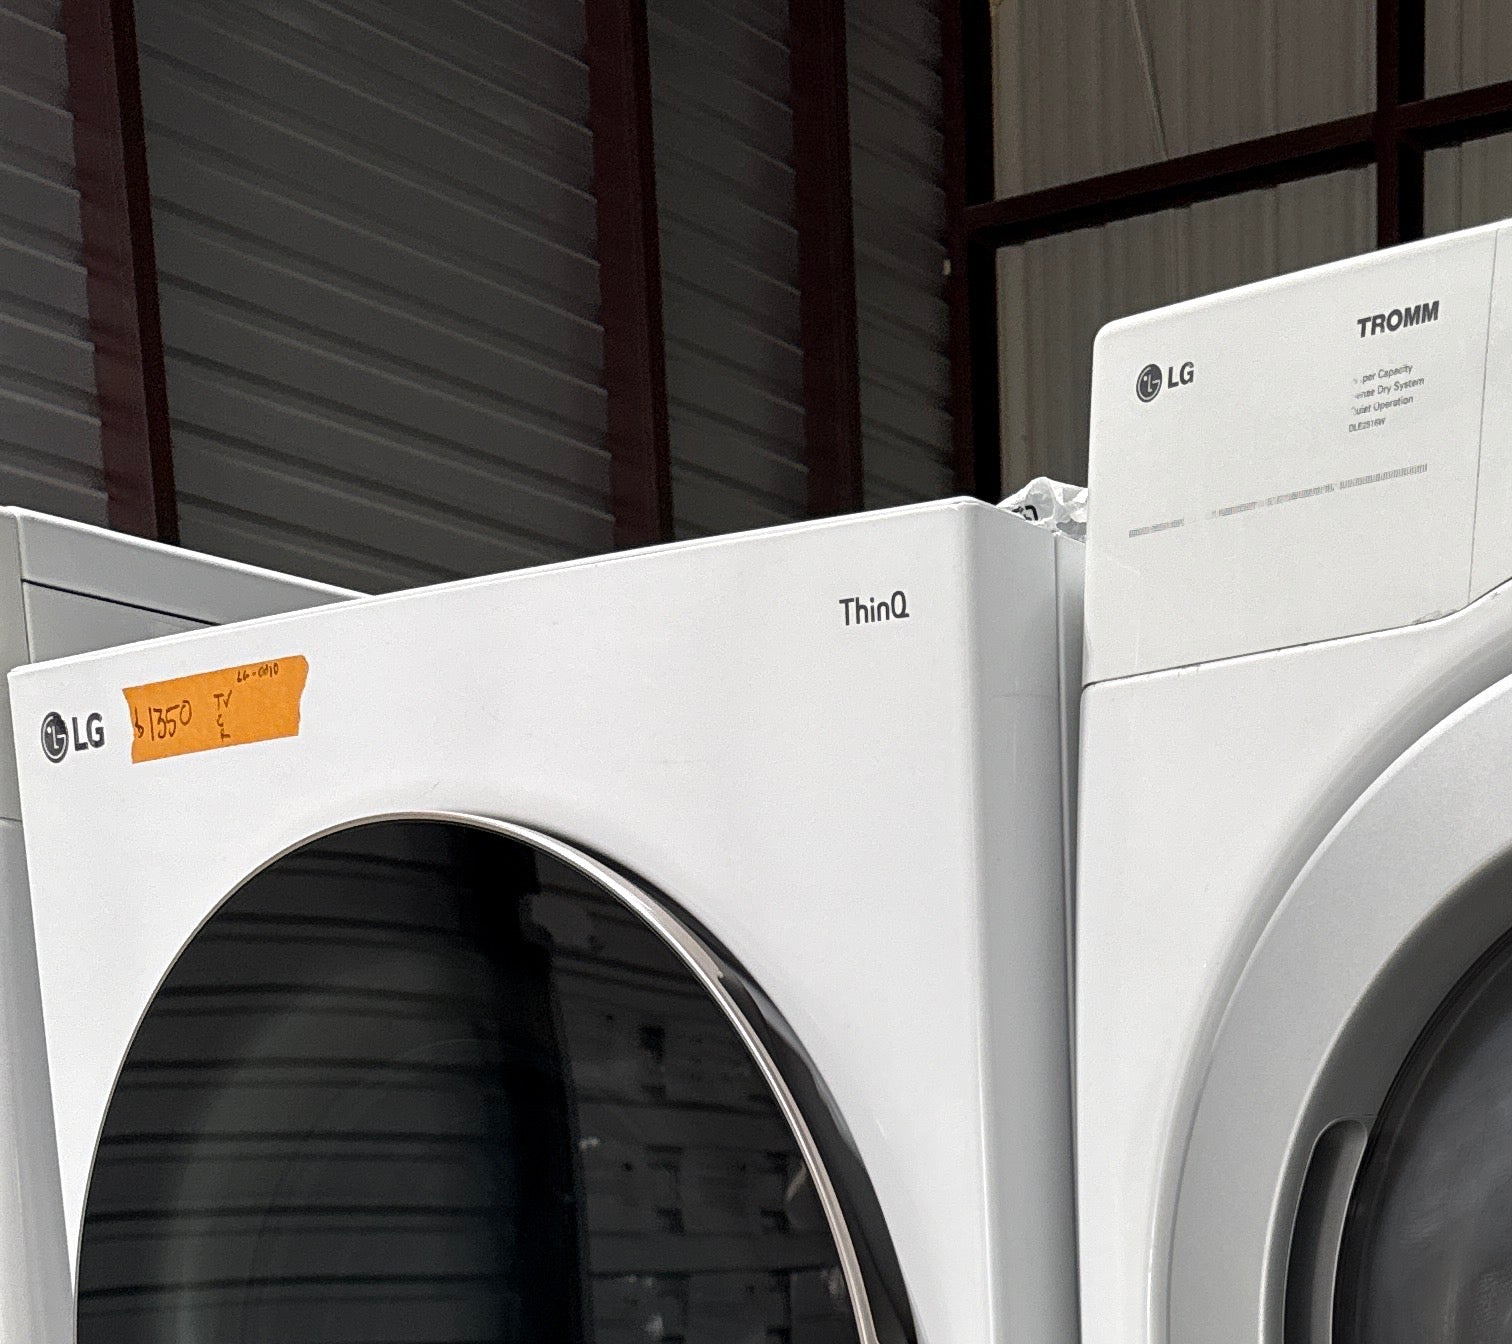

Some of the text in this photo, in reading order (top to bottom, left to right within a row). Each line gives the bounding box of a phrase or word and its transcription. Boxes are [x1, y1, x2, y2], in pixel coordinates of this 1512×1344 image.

[1357, 301, 1440, 338] TROMM
[1167, 361, 1194, 389] LG
[1378, 385, 1391, 395] Dry
[1394, 378, 1424, 391] System
[839, 591, 910, 628] ThinQ
[72, 712, 105, 752] LG
